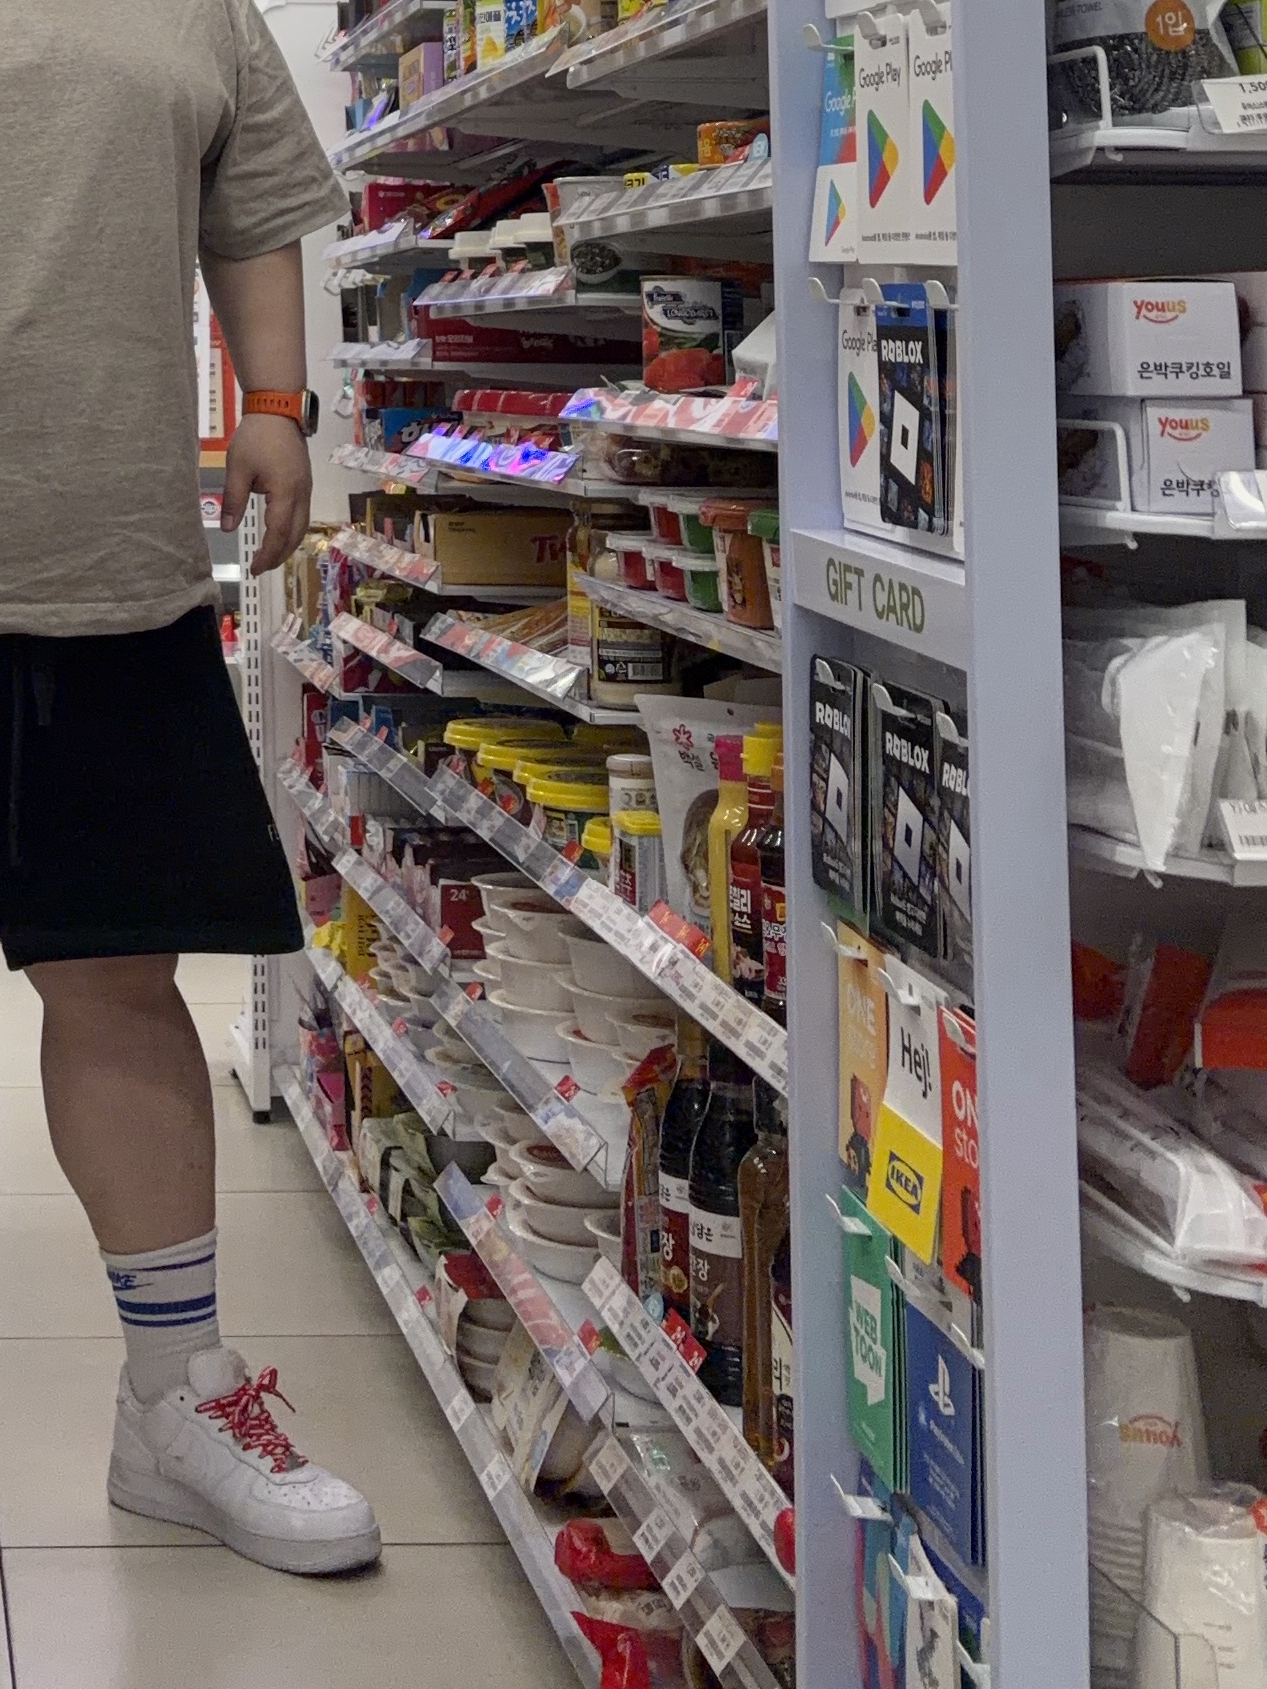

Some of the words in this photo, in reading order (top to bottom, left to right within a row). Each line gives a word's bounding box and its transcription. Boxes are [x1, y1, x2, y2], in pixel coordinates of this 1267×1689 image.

[858, 64, 885, 92] Google
[885, 62, 902, 88] Play
[913, 51, 943, 81] Google
[1133, 298, 1187, 321] youus
[841, 329, 866, 357] Google
[880, 338, 924, 365] ROBLOX
[1136, 360, 1232, 381] 은박쿠킹호일
[1157, 416, 1211, 438] youus
[826, 556, 865, 612] GIFT
[872, 572, 925, 634] CARD
[884, 730, 930, 775] ROBLOX
[900, 1025, 933, 1101] Hej!
[889, 1163, 920, 1202] IKEA
[852, 1322, 883, 1378] TOON
